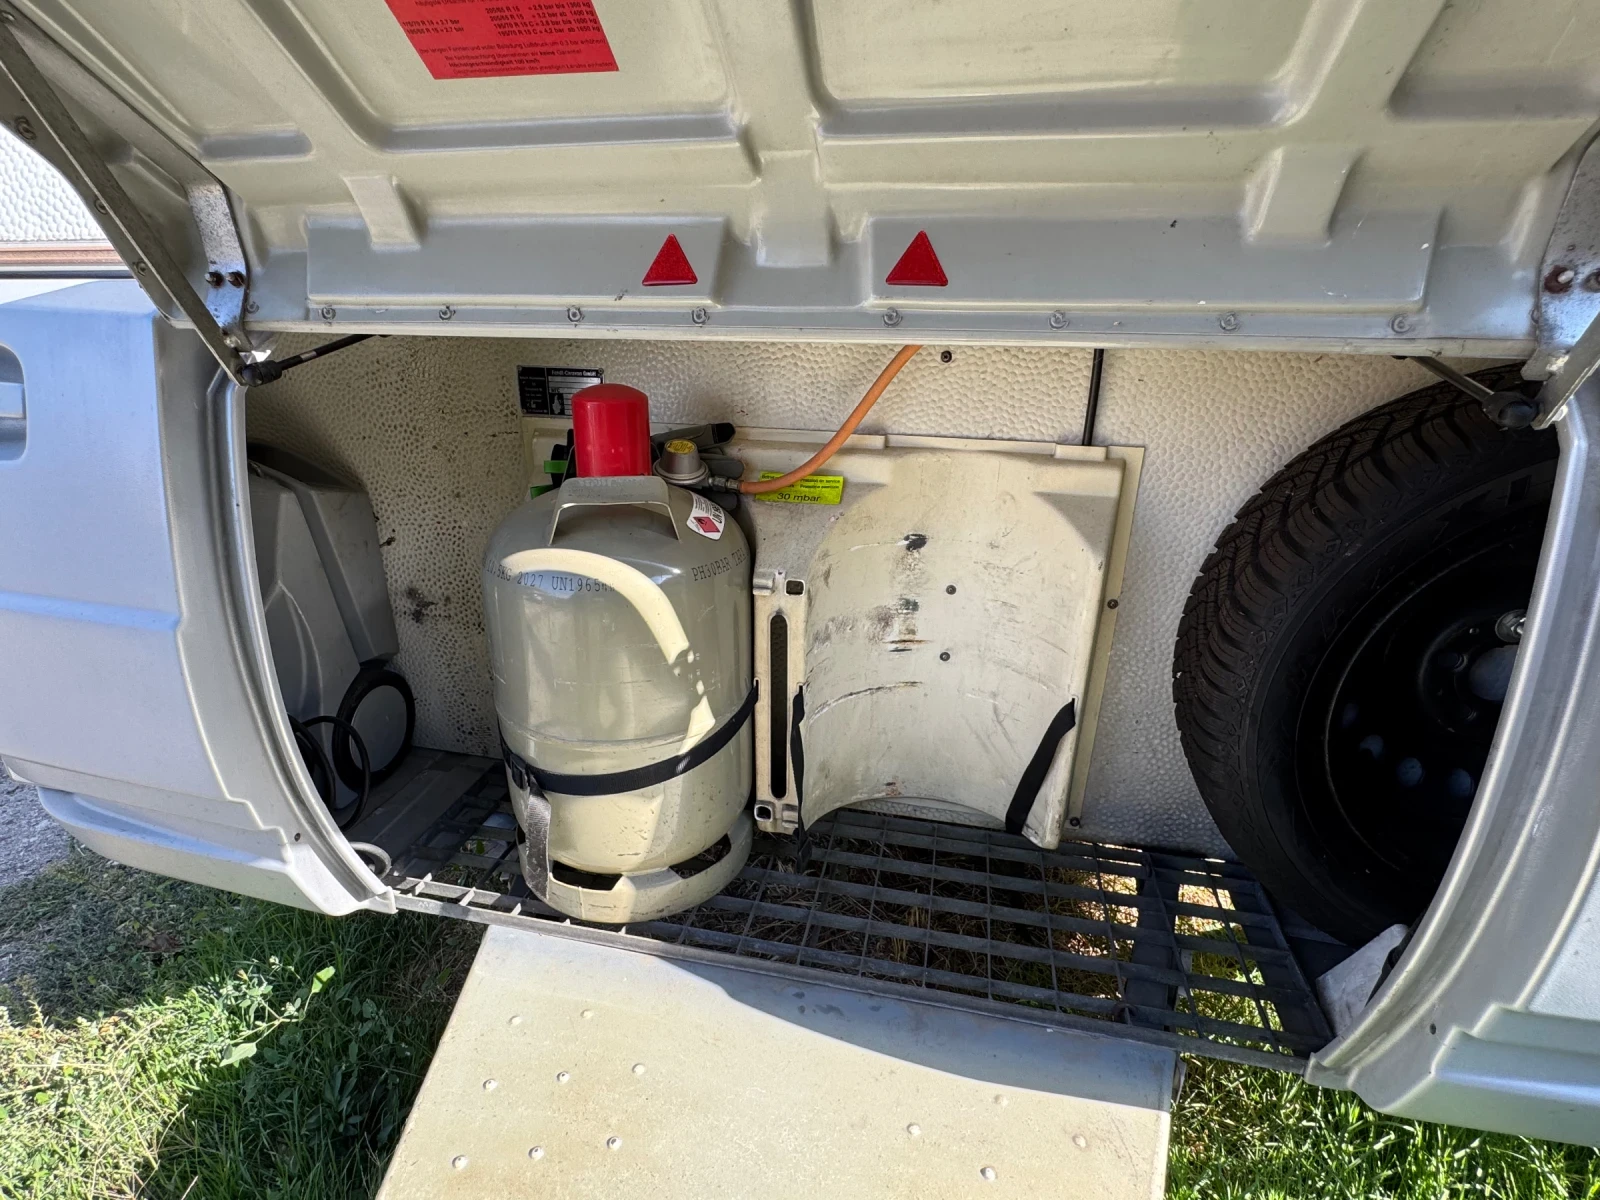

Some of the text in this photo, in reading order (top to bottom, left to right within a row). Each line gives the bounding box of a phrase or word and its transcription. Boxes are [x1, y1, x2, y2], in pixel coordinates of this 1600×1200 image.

[585, 9, 594, 17] kg
[588, 17, 597, 25] kg
[777, 492, 821, 502] 30 mbar
[516, 571, 544, 588] 2027
